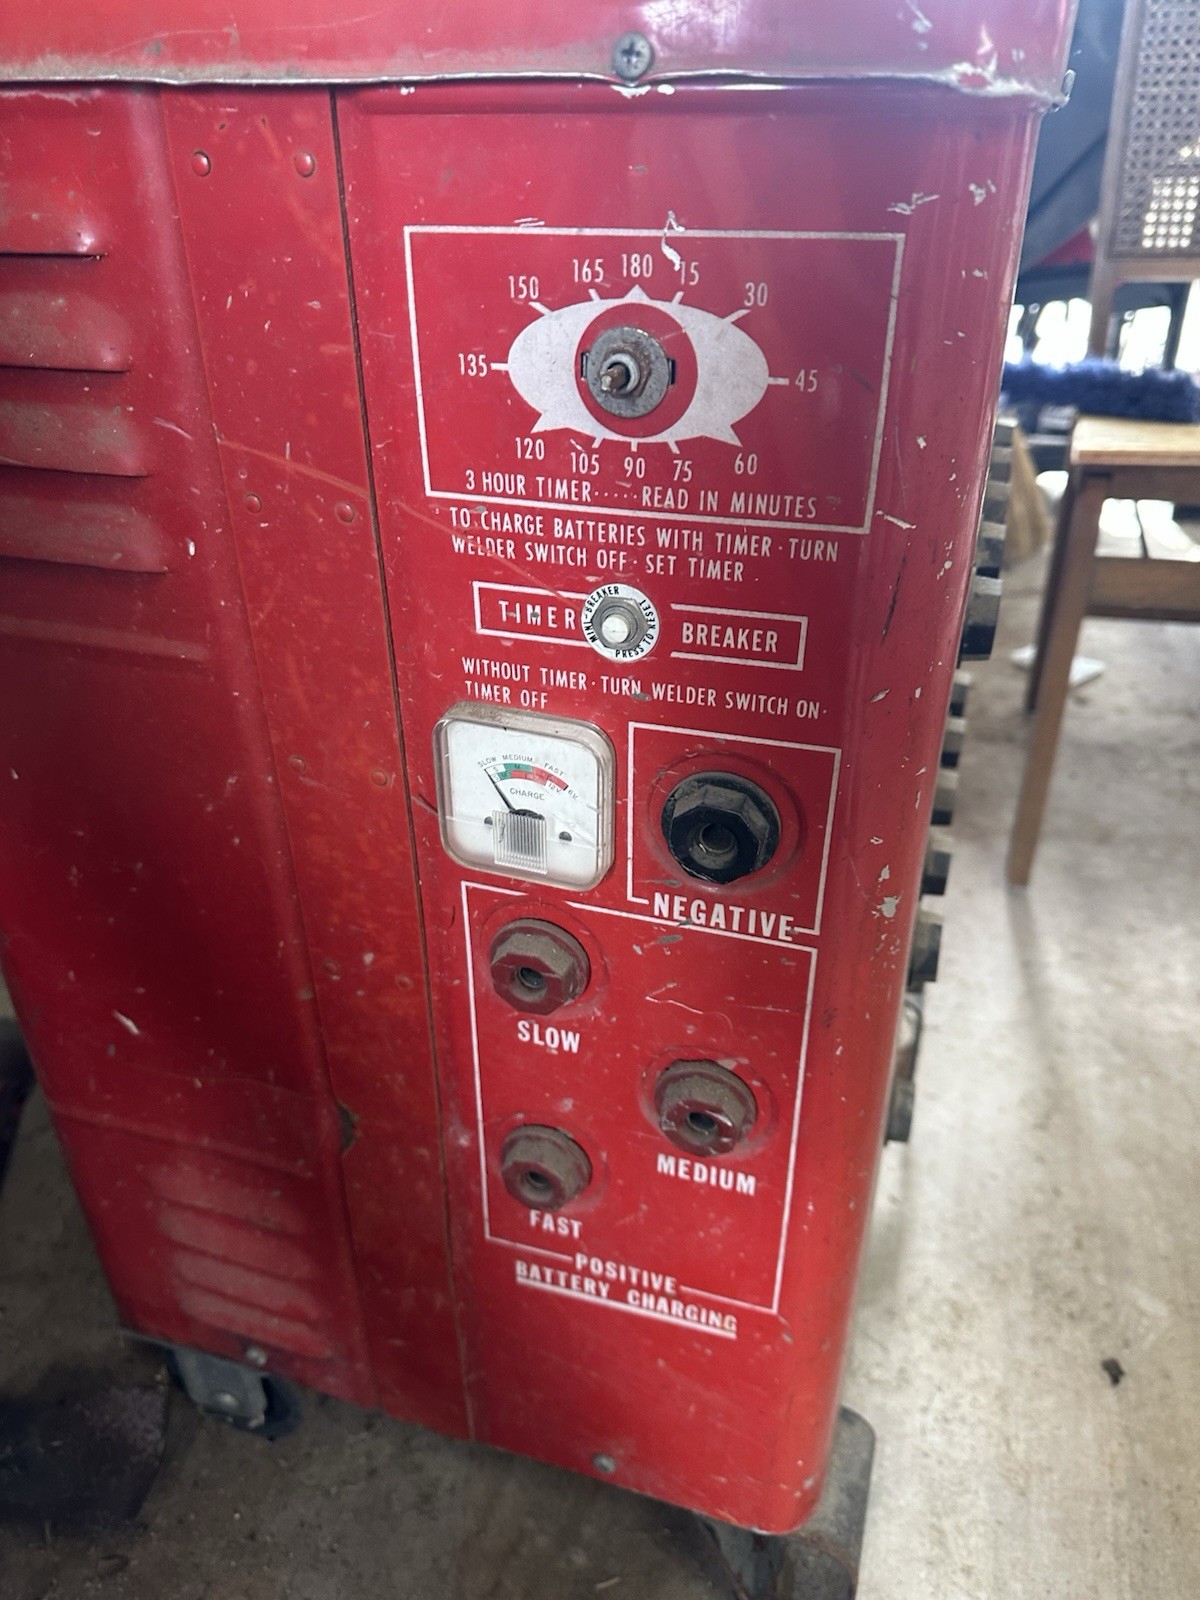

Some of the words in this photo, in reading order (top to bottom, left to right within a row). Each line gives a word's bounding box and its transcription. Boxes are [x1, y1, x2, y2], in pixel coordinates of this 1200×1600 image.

[573, 259, 604, 283] 165
[621, 253, 653, 278] 180
[679, 261, 700, 286] 15
[509, 275, 539, 299] 150
[743, 282, 768, 307] 30
[458, 353, 488, 377] 135
[795, 369, 818, 392] 45
[515, 437, 545, 460] 120
[570, 452, 600, 475] 105
[624, 457, 646, 478] 90
[673, 459, 693, 483] 75
[734, 453, 758, 475] 60
[465, 469, 475, 490] 3
[482, 471, 526, 496] HOUR
[642, 485, 689, 510] READ
[699, 490, 718, 512] IN
[730, 491, 817, 518] MINUTES
[450, 507, 470, 527] TO
[481, 511, 544, 536] CHARGE
[554, 517, 646, 546] BATTERIES
[656, 527, 703, 552] WITH
[789, 538, 839, 562] TURN
[452, 534, 516, 559] WELDER
[525, 541, 587, 567] SWITCH
[596, 549, 627, 571] OFF
[645, 554, 677, 575] SET
[688, 557, 744, 582] TIMER
[498, 600, 576, 630] TIMER
[639, 599, 656, 630] RESET
[642, 633, 654, 645] TO
[681, 621, 778, 653] BREAKER
[615, 644, 645, 658] PRESS
[461, 656, 530, 683] WITHOUT
[600, 675, 642, 697] TURN
[651, 682, 717, 707] WELDER
[725, 691, 788, 716] SWITCH
[464, 680, 512, 704] TIMER
[520, 689, 548, 709] OFF
[477, 756, 497, 767] SLOW
[502, 754, 533, 762] MEDIUM
[544, 762, 565, 776] FAST
[509, 788, 545, 801] CHARGE
[653, 891, 795, 942] NEGATIVE
[517, 1019, 581, 1054] SLOW
[656, 1153, 757, 1196] MEDIUM
[528, 1209, 583, 1239] FAST
[575, 1252, 677, 1295] POSITIVE
[515, 1259, 610, 1299] BATTERY
[626, 1288, 738, 1333] CHARGING
